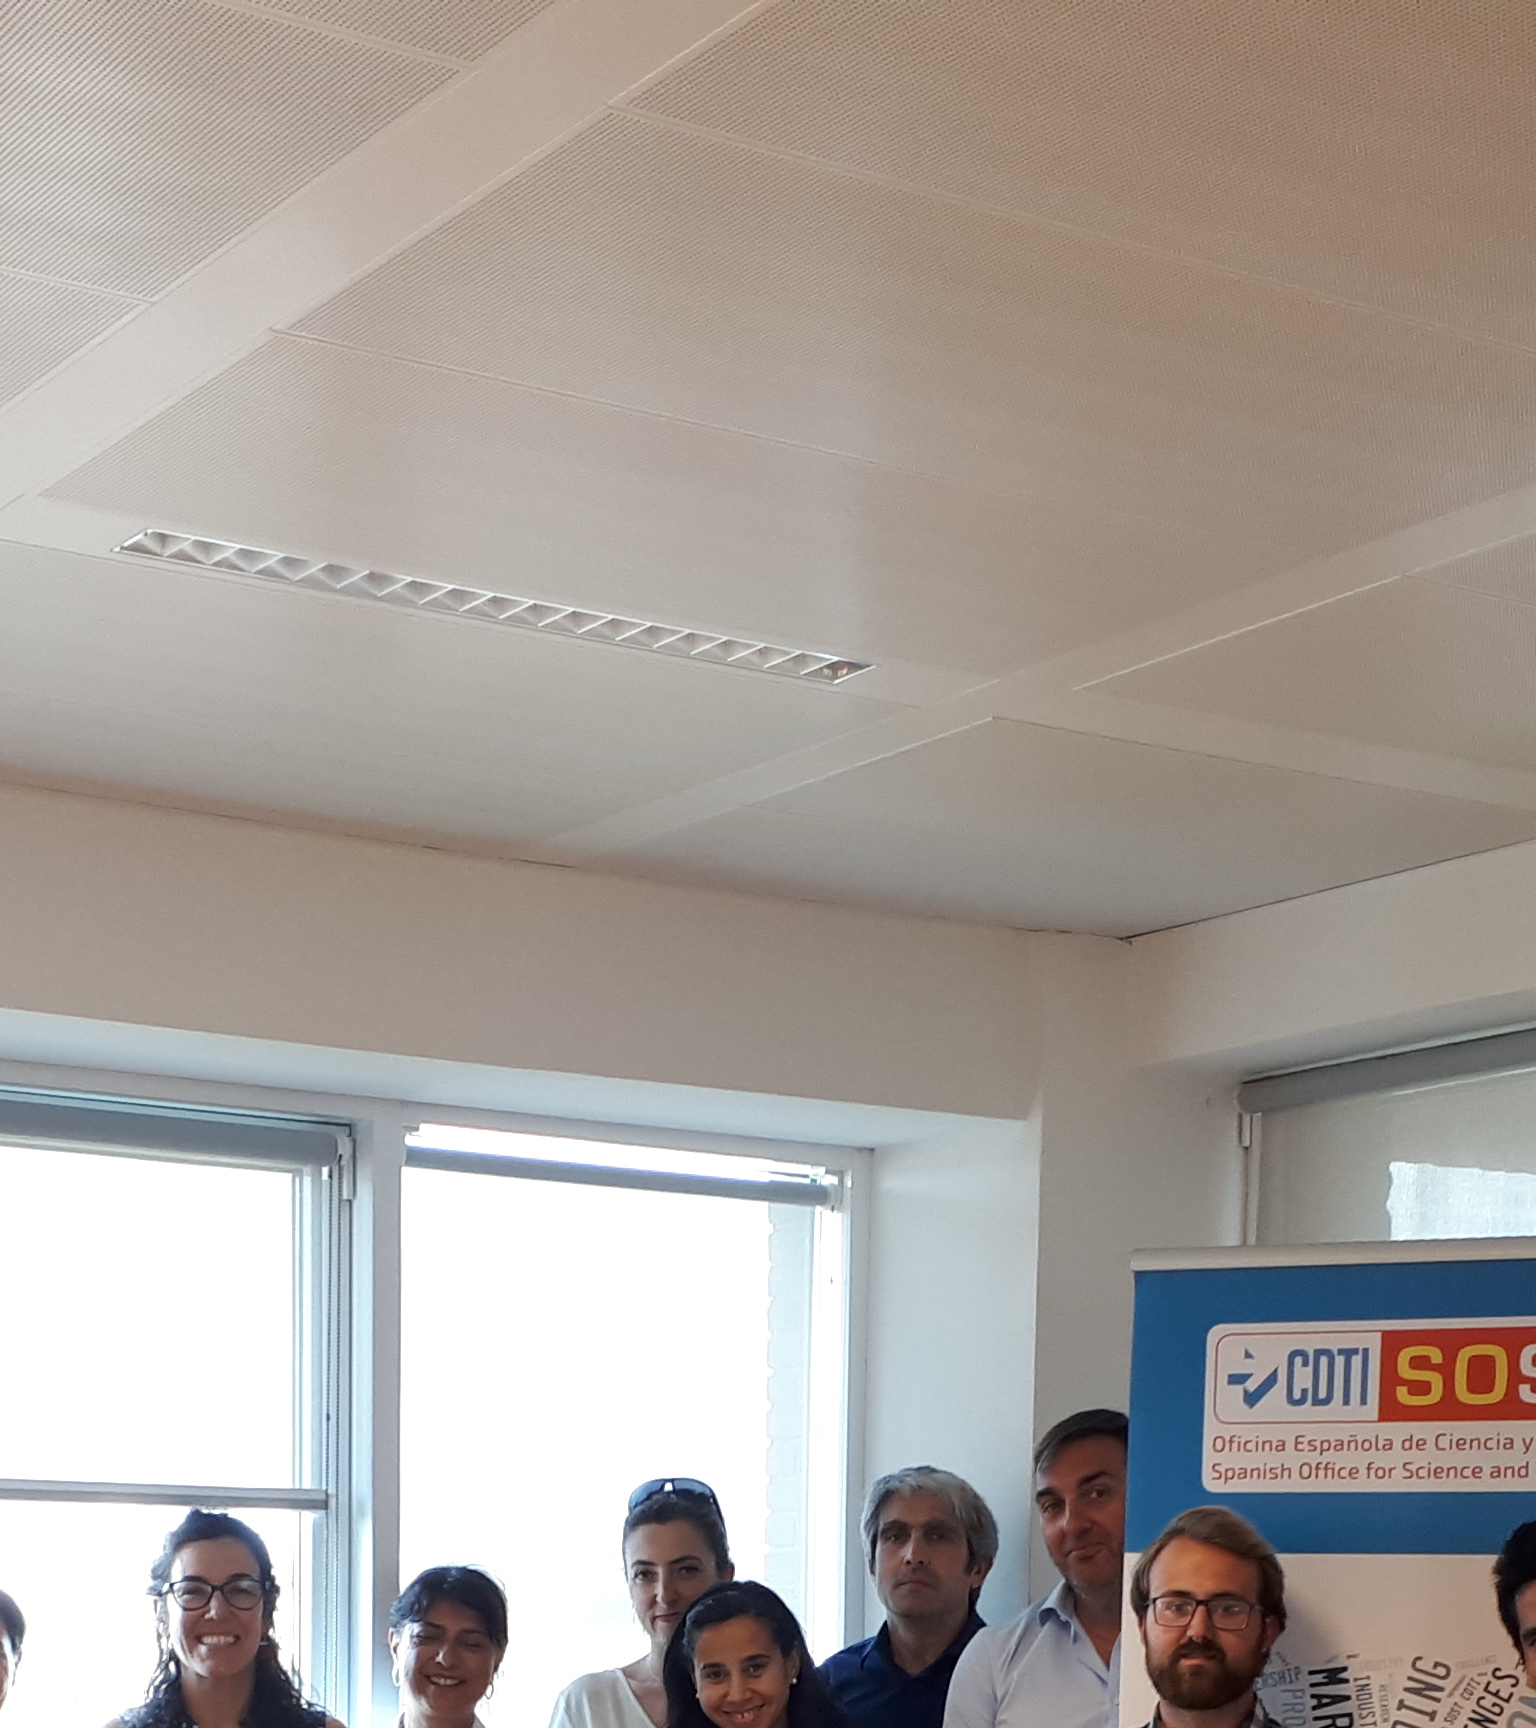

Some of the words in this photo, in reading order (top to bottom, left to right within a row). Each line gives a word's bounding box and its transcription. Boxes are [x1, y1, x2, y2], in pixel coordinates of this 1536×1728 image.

[1286, 1346, 1370, 1407] CDTI
[1212, 1434, 1286, 1453] Oficina
[1294, 1434, 1393, 1456] Española
[1401, 1434, 1427, 1452] de
[1434, 1433, 1515, 1451] Ciencia
[1521, 1436, 1534, 1455] y
[1211, 1463, 1291, 1484] Spanish
[1299, 1462, 1360, 1480] Office
[1366, 1462, 1396, 1480] for
[1402, 1461, 1483, 1480] Science
[1489, 1461, 1530, 1479] and
